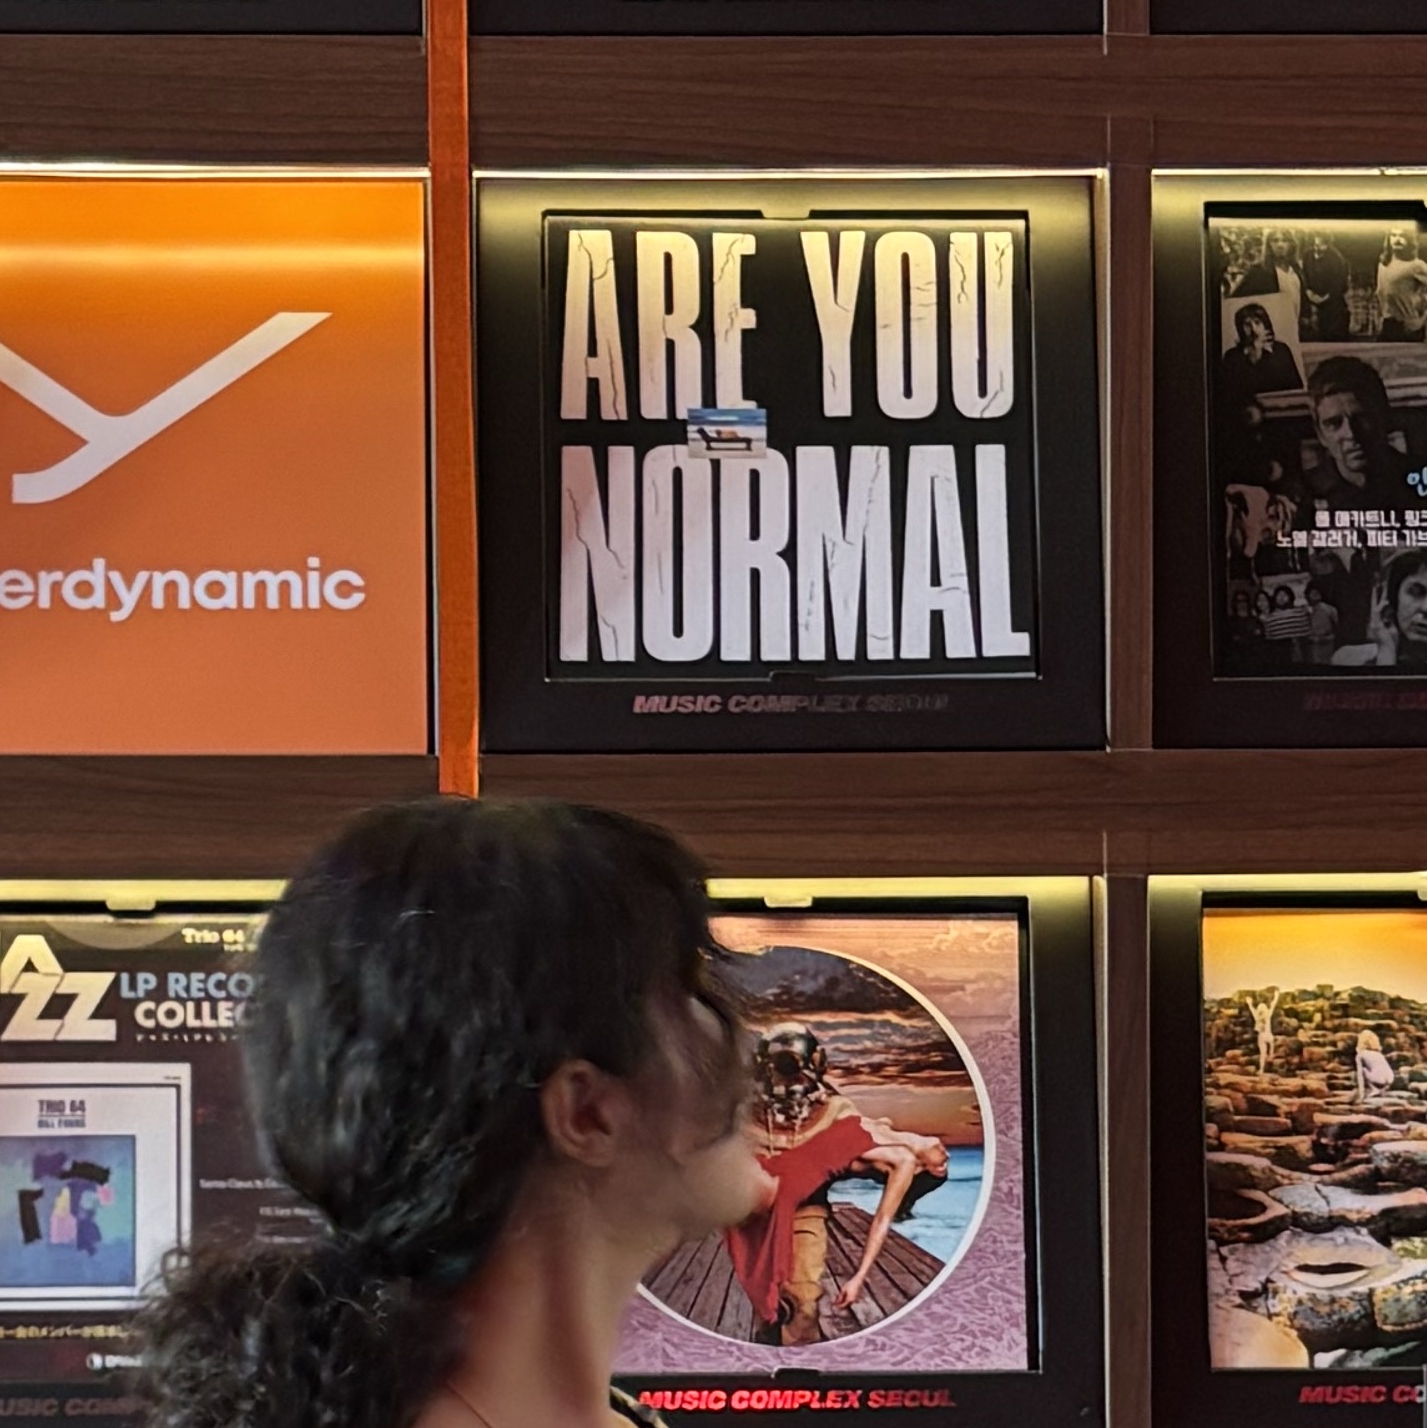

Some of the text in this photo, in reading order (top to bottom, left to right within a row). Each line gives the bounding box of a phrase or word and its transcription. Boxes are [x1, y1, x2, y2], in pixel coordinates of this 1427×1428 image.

[560, 230, 1014, 420] ARE YOU
[559, 444, 1031, 662] NORMAL
[633, 695, 722, 713] MUSIC
[729, 693, 858, 713] COMPLEX
[181, 927, 218, 945] Trio
[120, 972, 254, 999] LP RECO
[639, 1389, 957, 1409] MUSIC COMPLEX SEOUL
[1299, 1384, 1385, 1402] MUSIC
